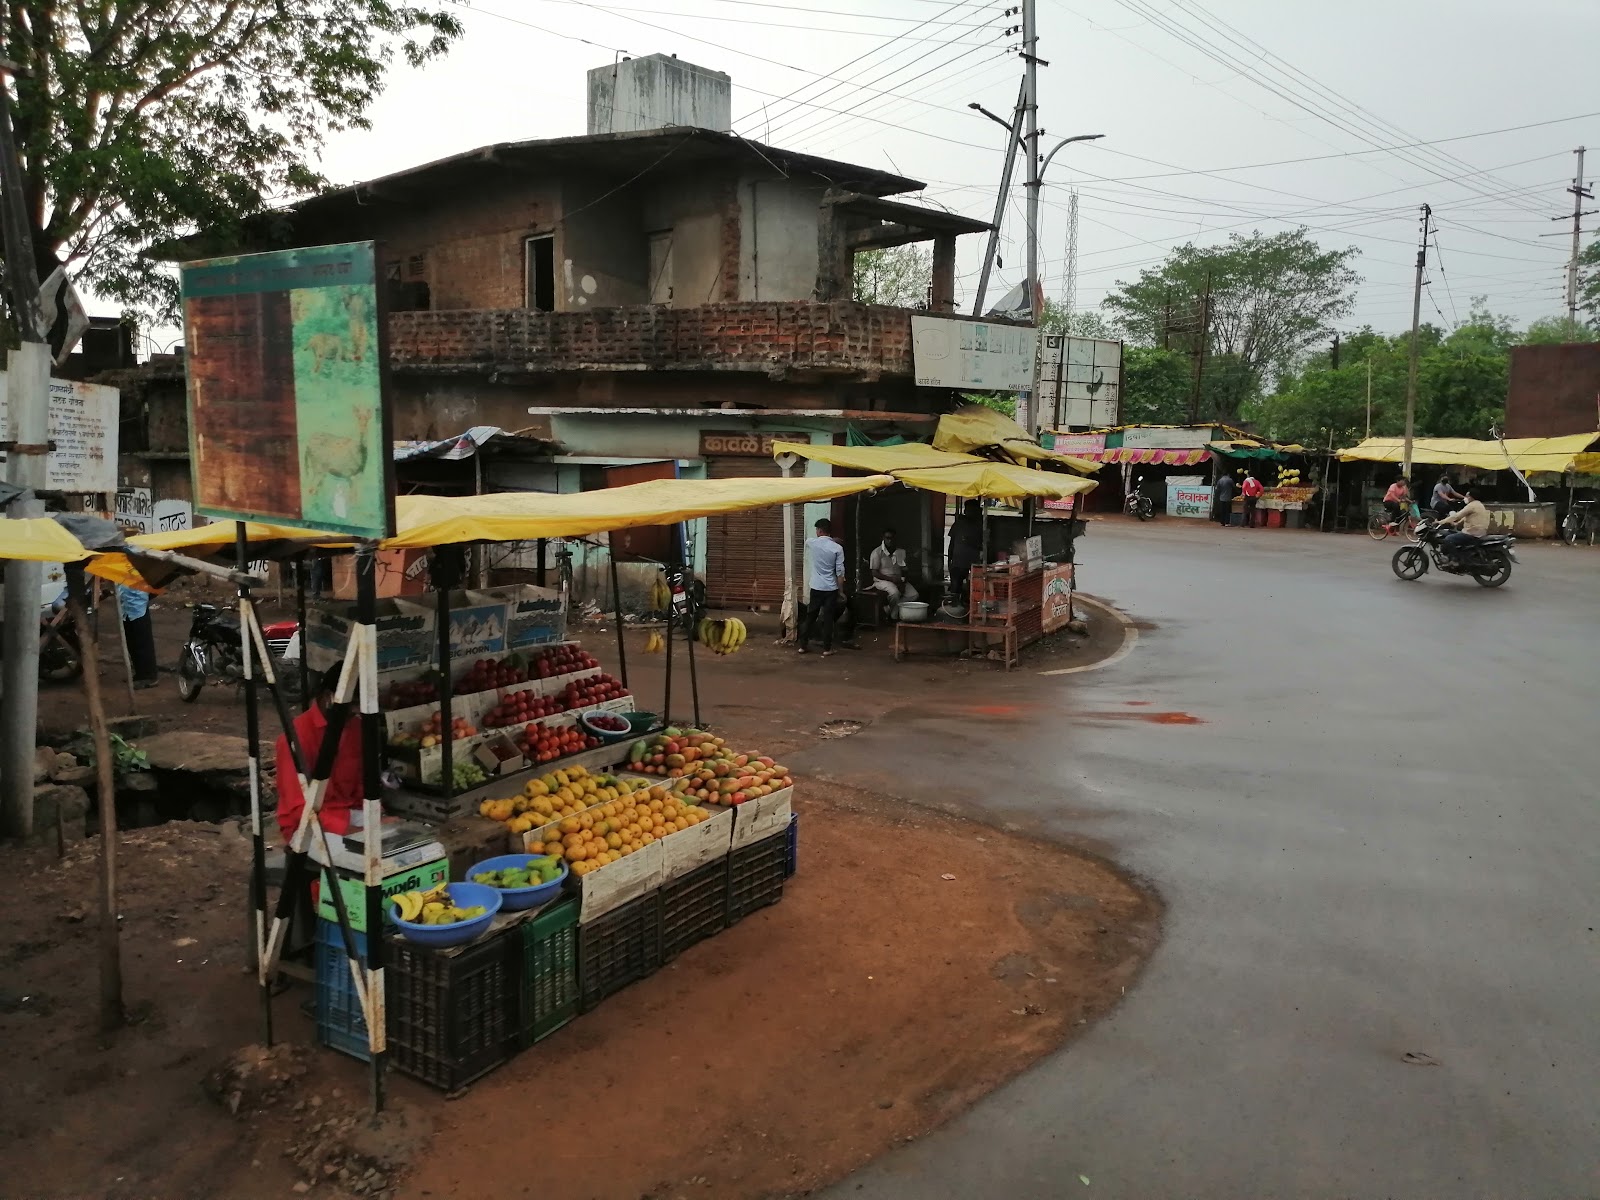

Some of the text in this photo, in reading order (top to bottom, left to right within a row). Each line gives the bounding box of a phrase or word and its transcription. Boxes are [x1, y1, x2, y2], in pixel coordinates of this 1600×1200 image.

[703, 432, 759, 453] कावळे
[1175, 489, 1211, 504] दिवाकर
[1175, 501, 1201, 515] हॉटेल
[465, 645, 490, 656] HORN
